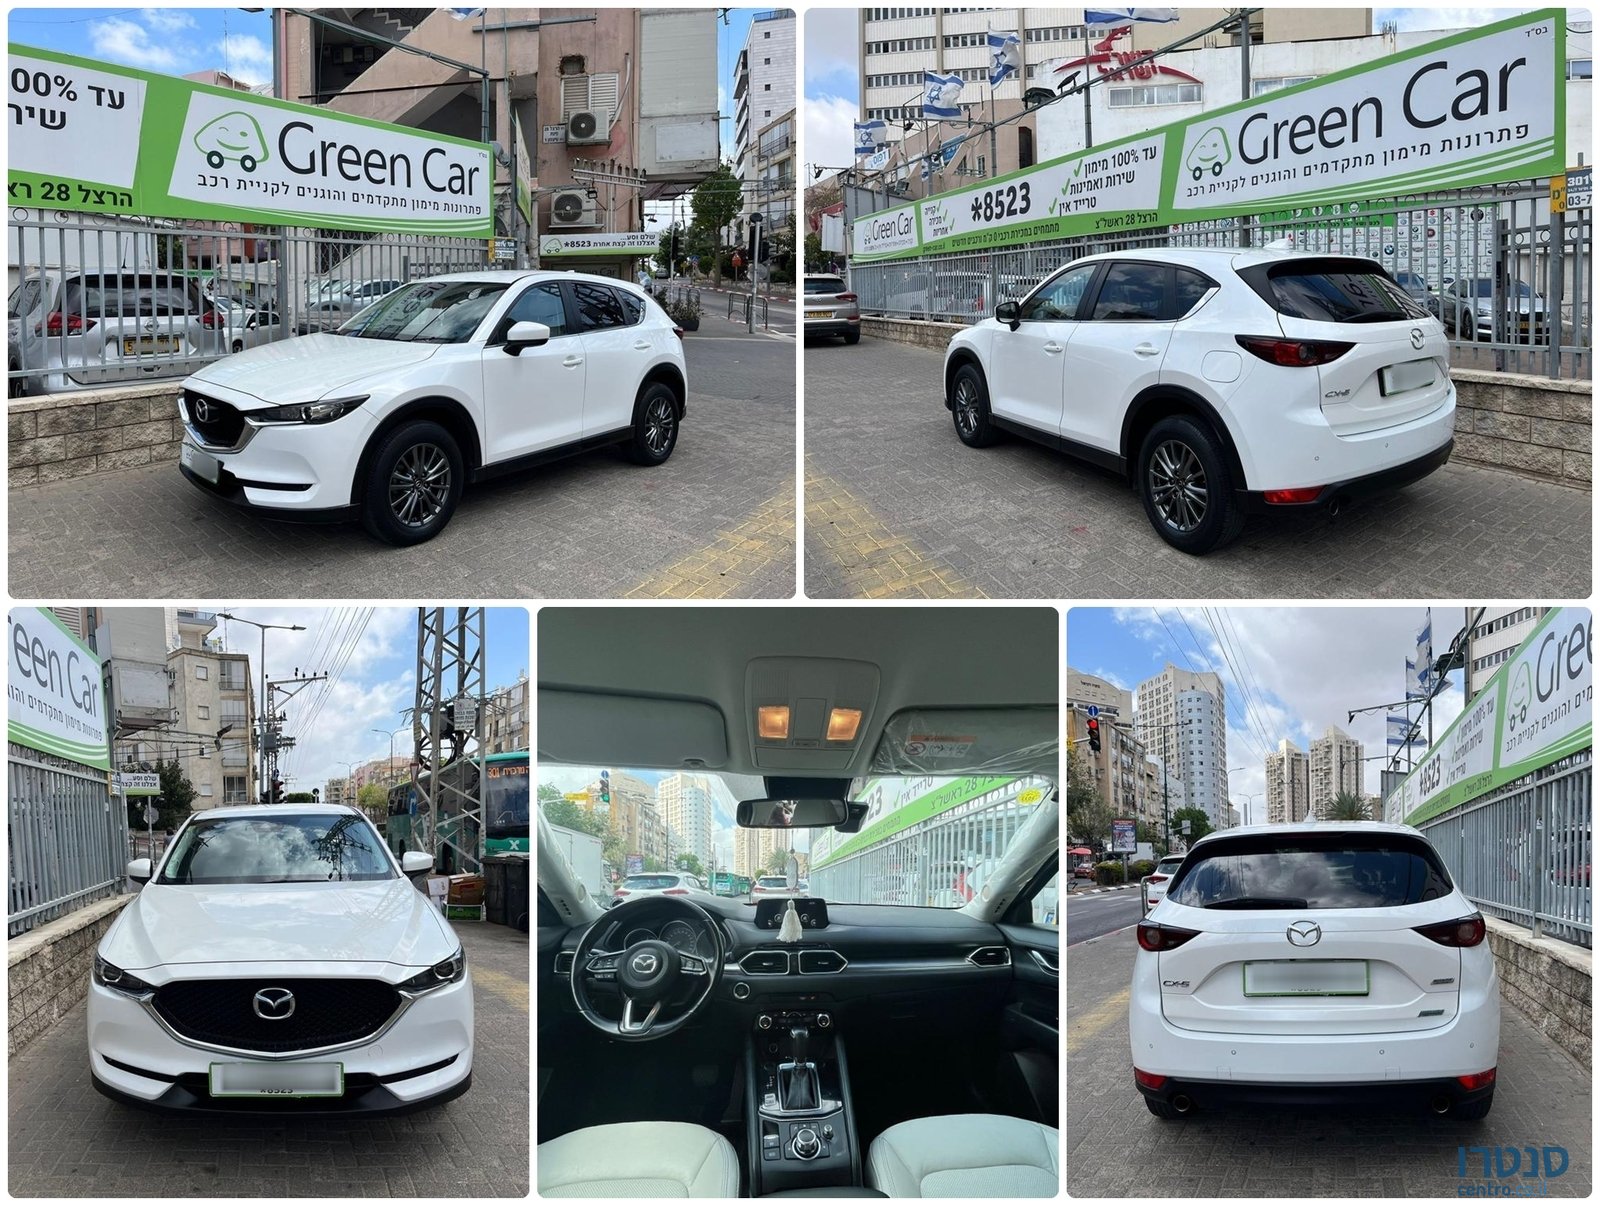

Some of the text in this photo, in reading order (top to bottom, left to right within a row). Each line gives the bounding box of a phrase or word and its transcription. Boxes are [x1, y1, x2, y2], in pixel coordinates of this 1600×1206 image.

[88, 85, 125, 110] עד
[1238, 57, 1527, 165] Green Car
[278, 121, 411, 188] Green
[422, 147, 480, 196] Car
[1084, 146, 1157, 178] עד 100% מימון
[1186, 123, 1530, 197] פתרונות מימון מתקדמים והוגנים לקניית רכב
[40, 182, 70, 201] 28
[78, 184, 133, 207] הרצל
[197, 173, 481, 215] פתרונות מימון מתקדמים והוגנים לקניית רכב
[1069, 170, 1135, 196] שירות ואמינות
[1059, 196, 1097, 217] טרייד אין
[1125, 213, 1135, 225] 28
[1137, 212, 1158, 223] הרצל
[872, 212, 914, 241] Green Car
[1033, 222, 1060, 236] מתמחים
[8, 614, 98, 718] een Car
[27, 694, 63, 722] מתקדמים
[1541, 700, 1571, 730] והוגנים
[1163, 980, 1190, 988] CX-5
